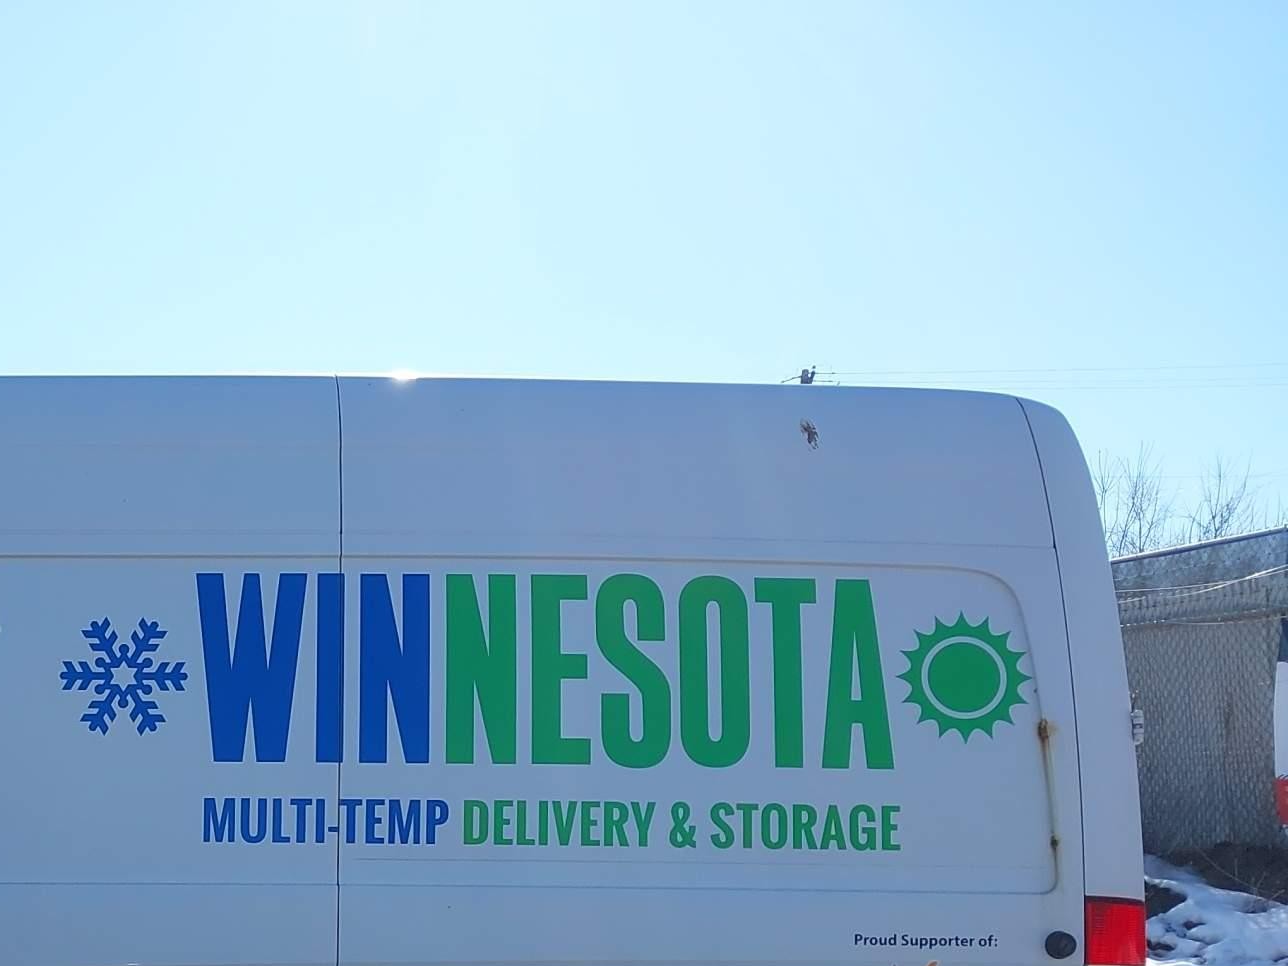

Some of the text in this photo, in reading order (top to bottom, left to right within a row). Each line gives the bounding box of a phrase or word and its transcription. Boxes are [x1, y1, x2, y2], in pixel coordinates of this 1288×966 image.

[196, 573, 895, 769] WINNESOTA
[202, 798, 901, 852] MULTI-TEMP DELIVERY & STORAGE
[854, 934, 998, 949] Proud Supporter of:
